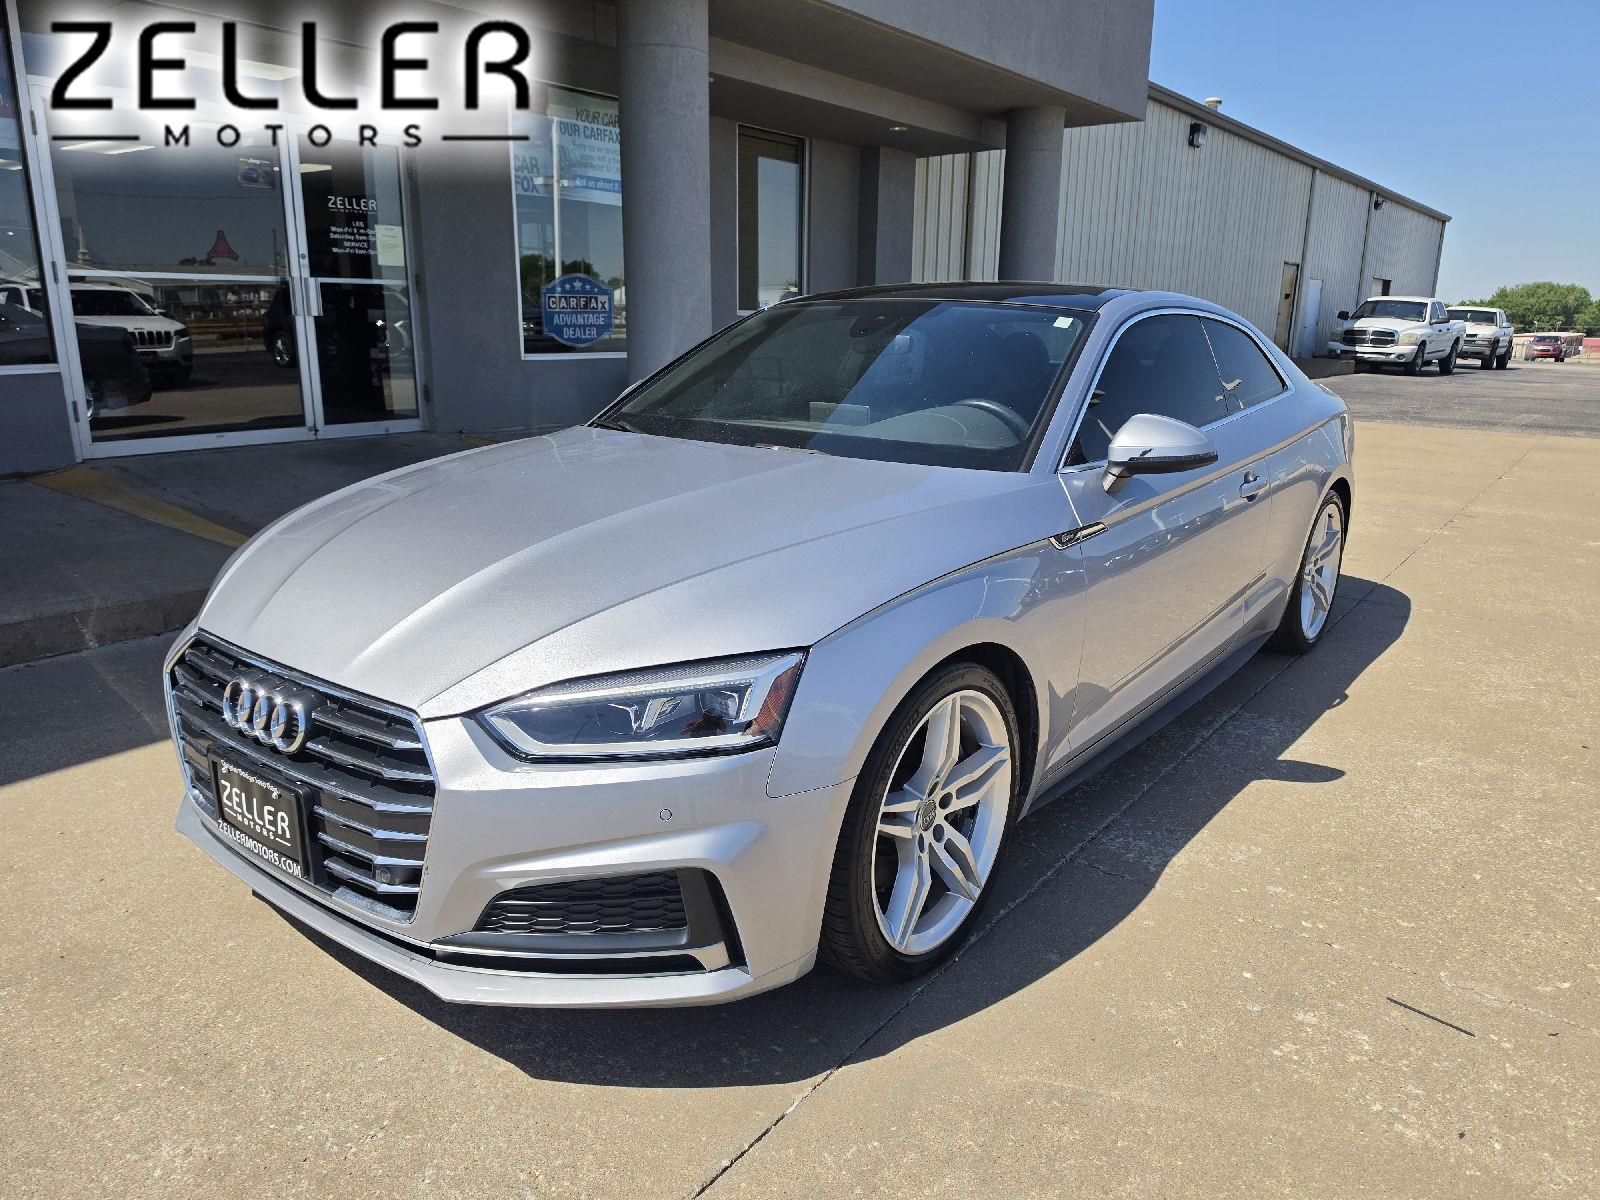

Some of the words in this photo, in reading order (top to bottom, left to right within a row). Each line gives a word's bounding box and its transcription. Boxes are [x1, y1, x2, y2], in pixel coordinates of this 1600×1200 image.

[575, 108, 600, 125] YOUR
[560, 121, 581, 137] OUR
[583, 125, 621, 145] CARFAX
[327, 196, 377, 211] ZELLER
[549, 297, 607, 311] CARFAX
[553, 313, 605, 326] ADVANTAGE
[563, 326, 598, 339] DEALER
[220, 779, 291, 839] ZELLER
[237, 814, 275, 840] MOTORS
[218, 818, 302, 879] ZELLERMOTORS.COM
